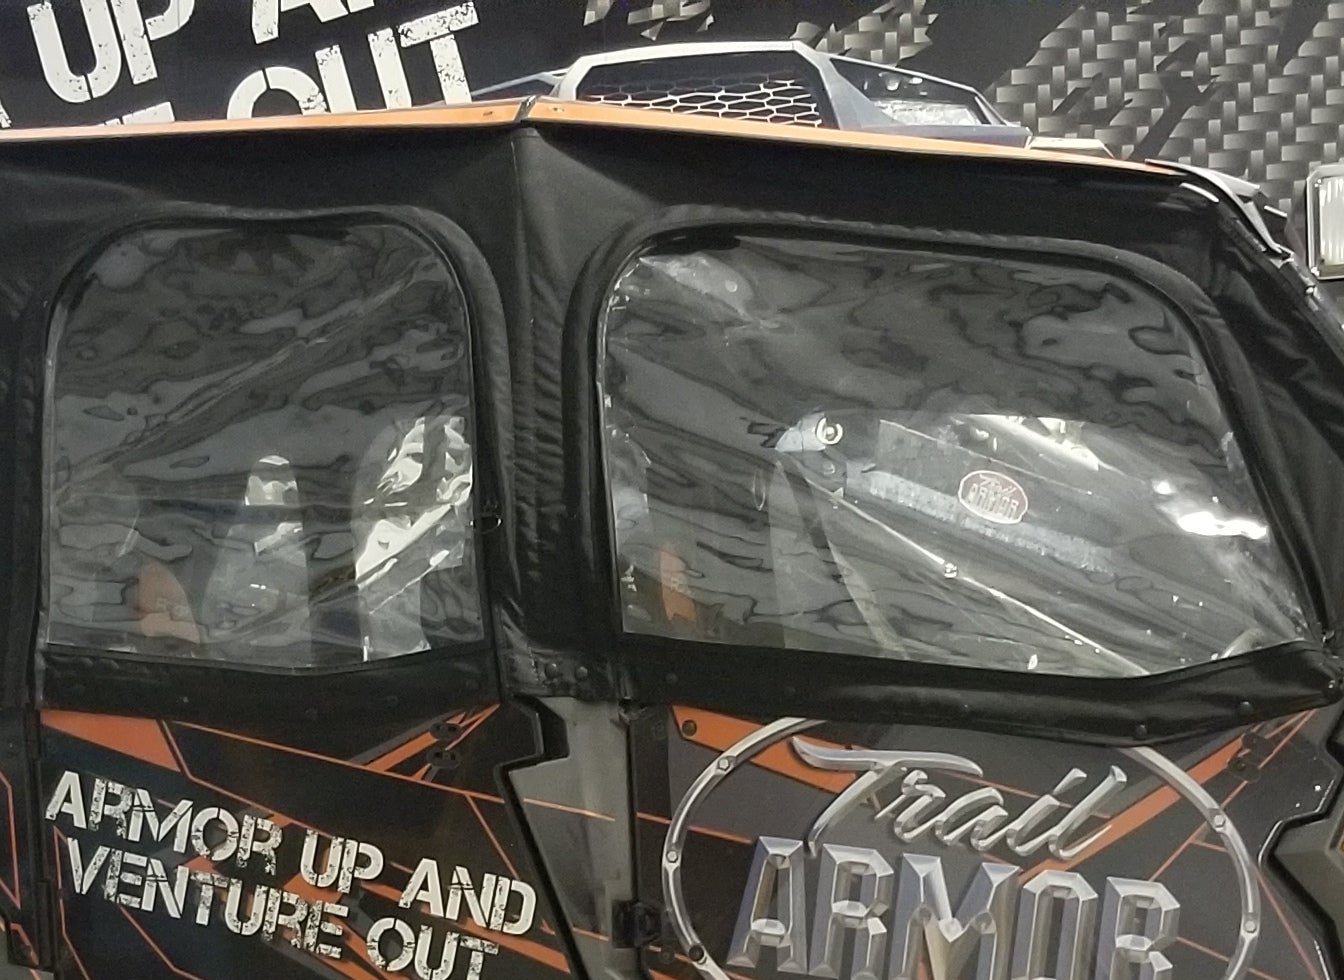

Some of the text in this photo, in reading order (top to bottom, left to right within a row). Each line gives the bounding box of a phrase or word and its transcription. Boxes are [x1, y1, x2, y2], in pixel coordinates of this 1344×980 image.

[27, 0, 196, 103] UP
[45, 770, 537, 936] ARMOR UP AND
[790, 735, 1128, 861] Trail
[65, 836, 350, 960] VENTURE
